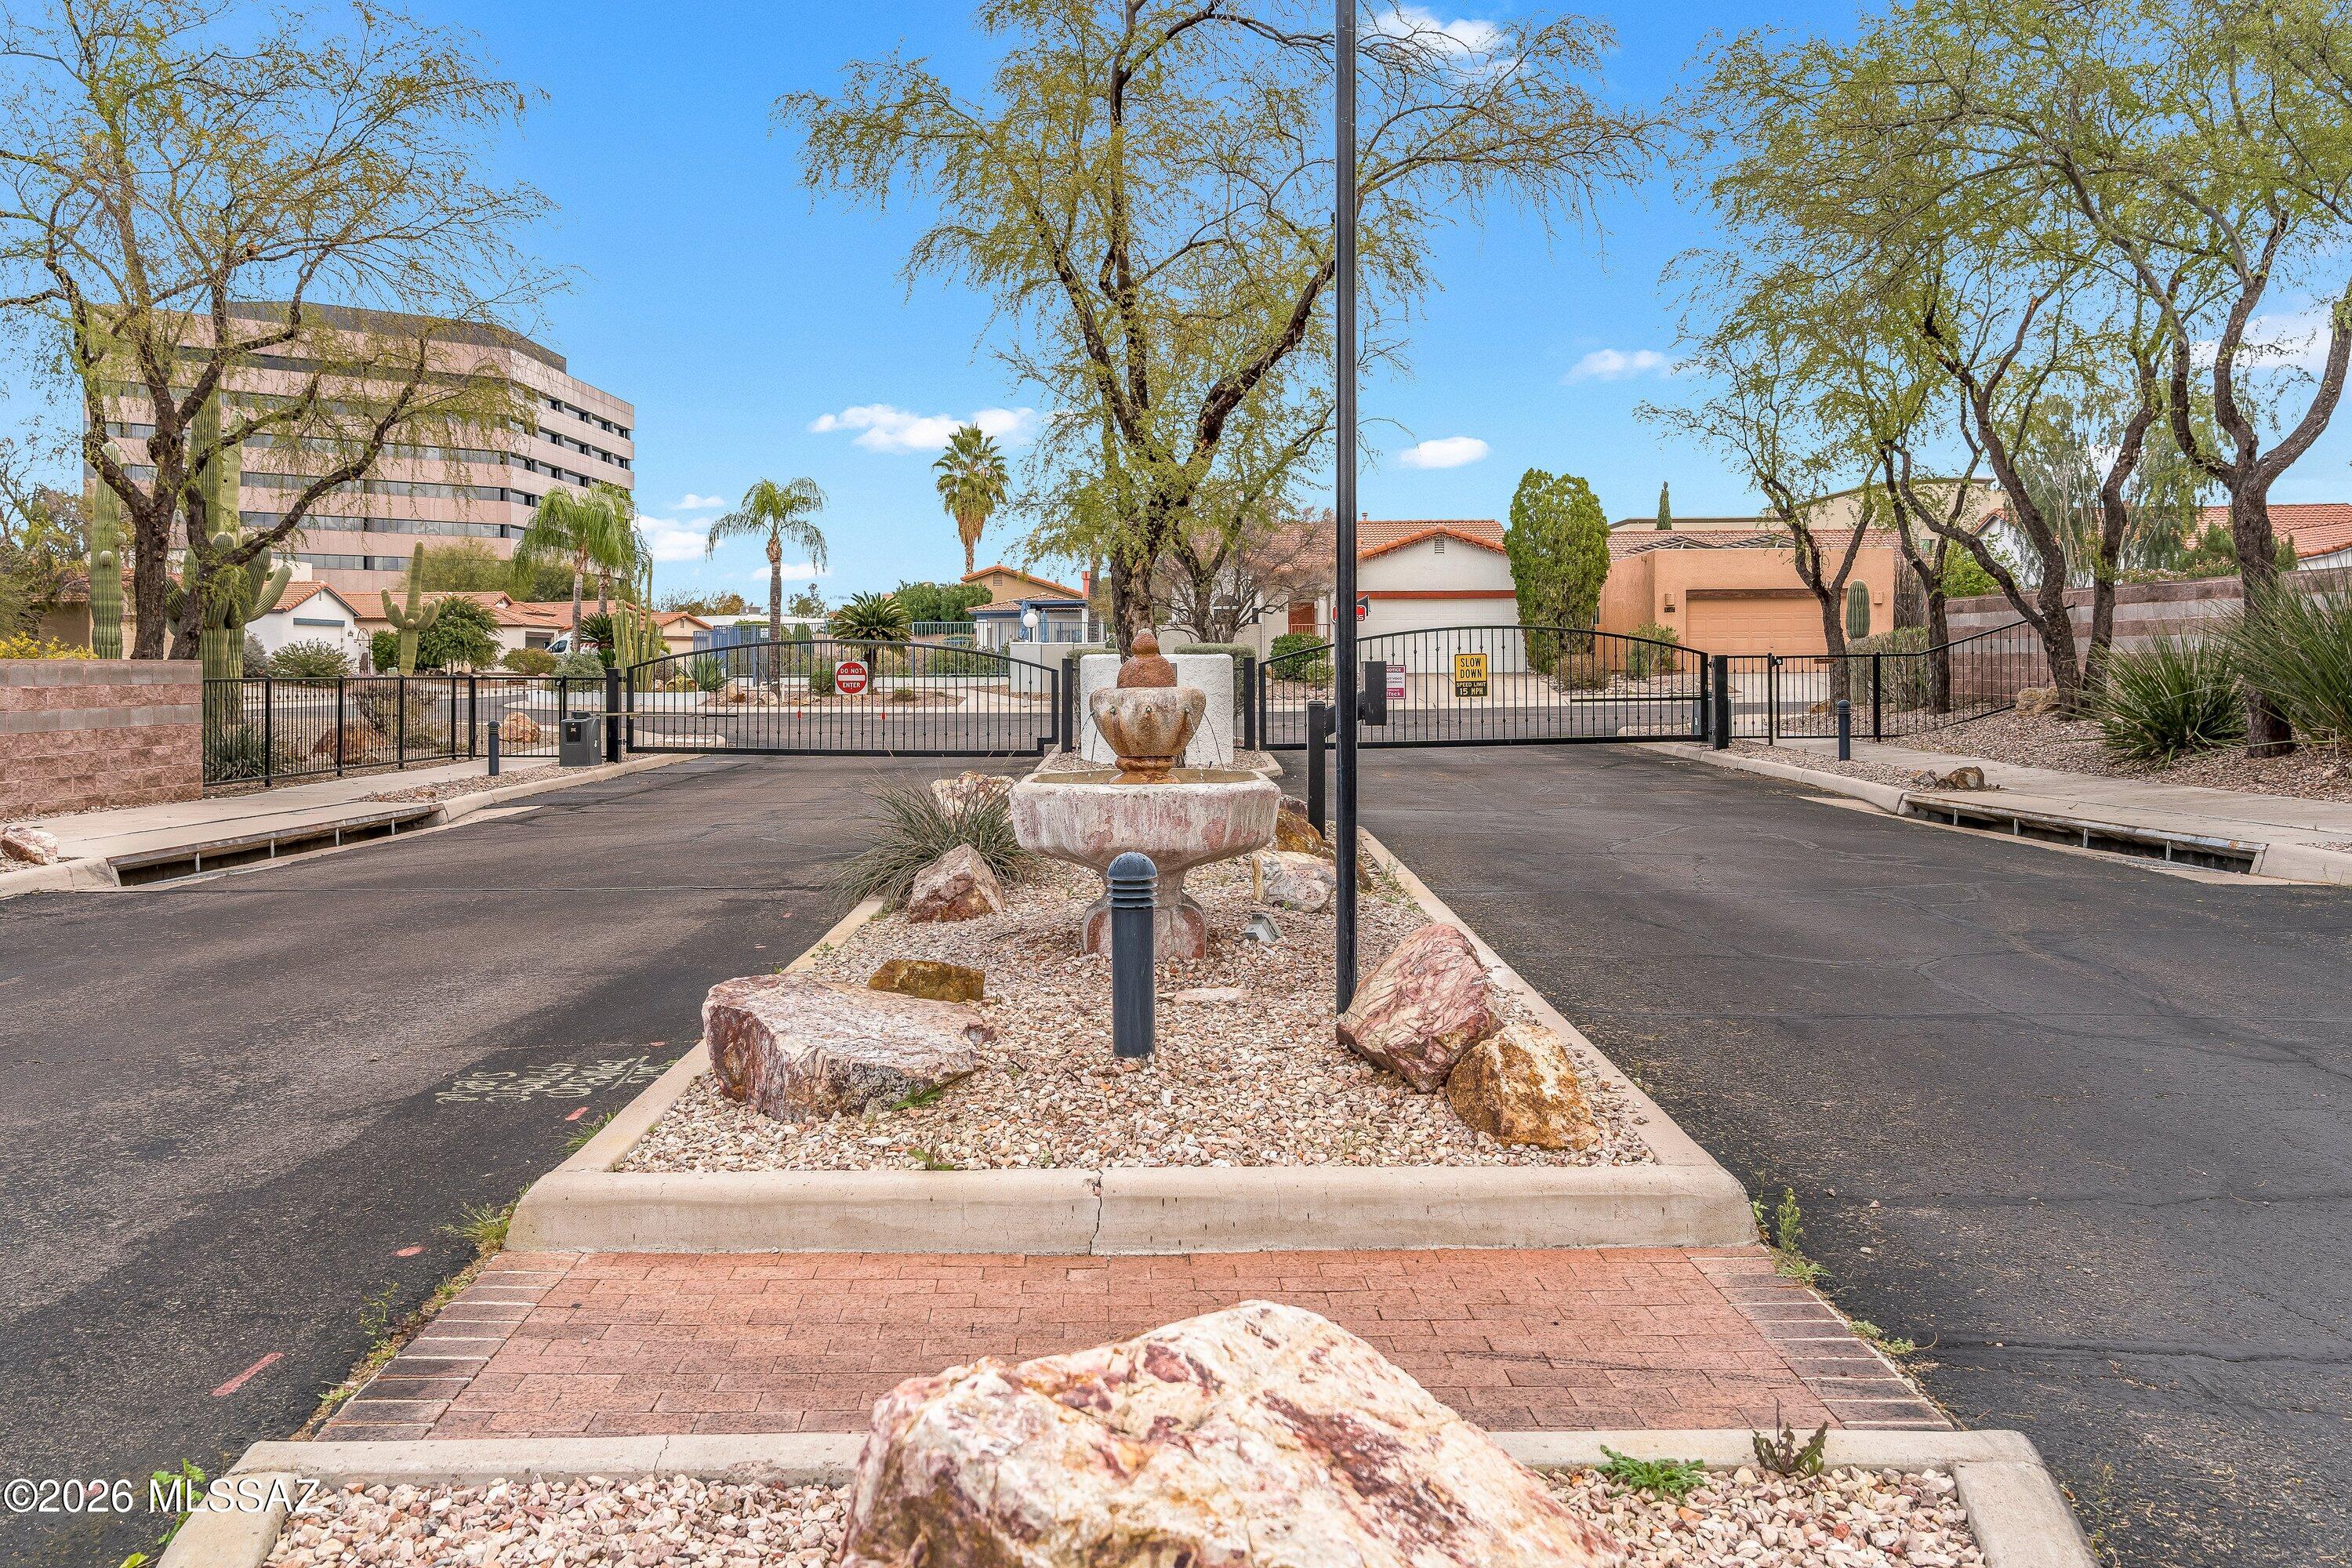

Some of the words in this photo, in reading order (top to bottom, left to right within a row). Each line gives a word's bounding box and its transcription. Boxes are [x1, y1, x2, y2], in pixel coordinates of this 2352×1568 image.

[1461, 657, 1481, 667] SLOW
[1460, 669, 1482, 678] DOWN
[1471, 687, 1483, 695] MPH
